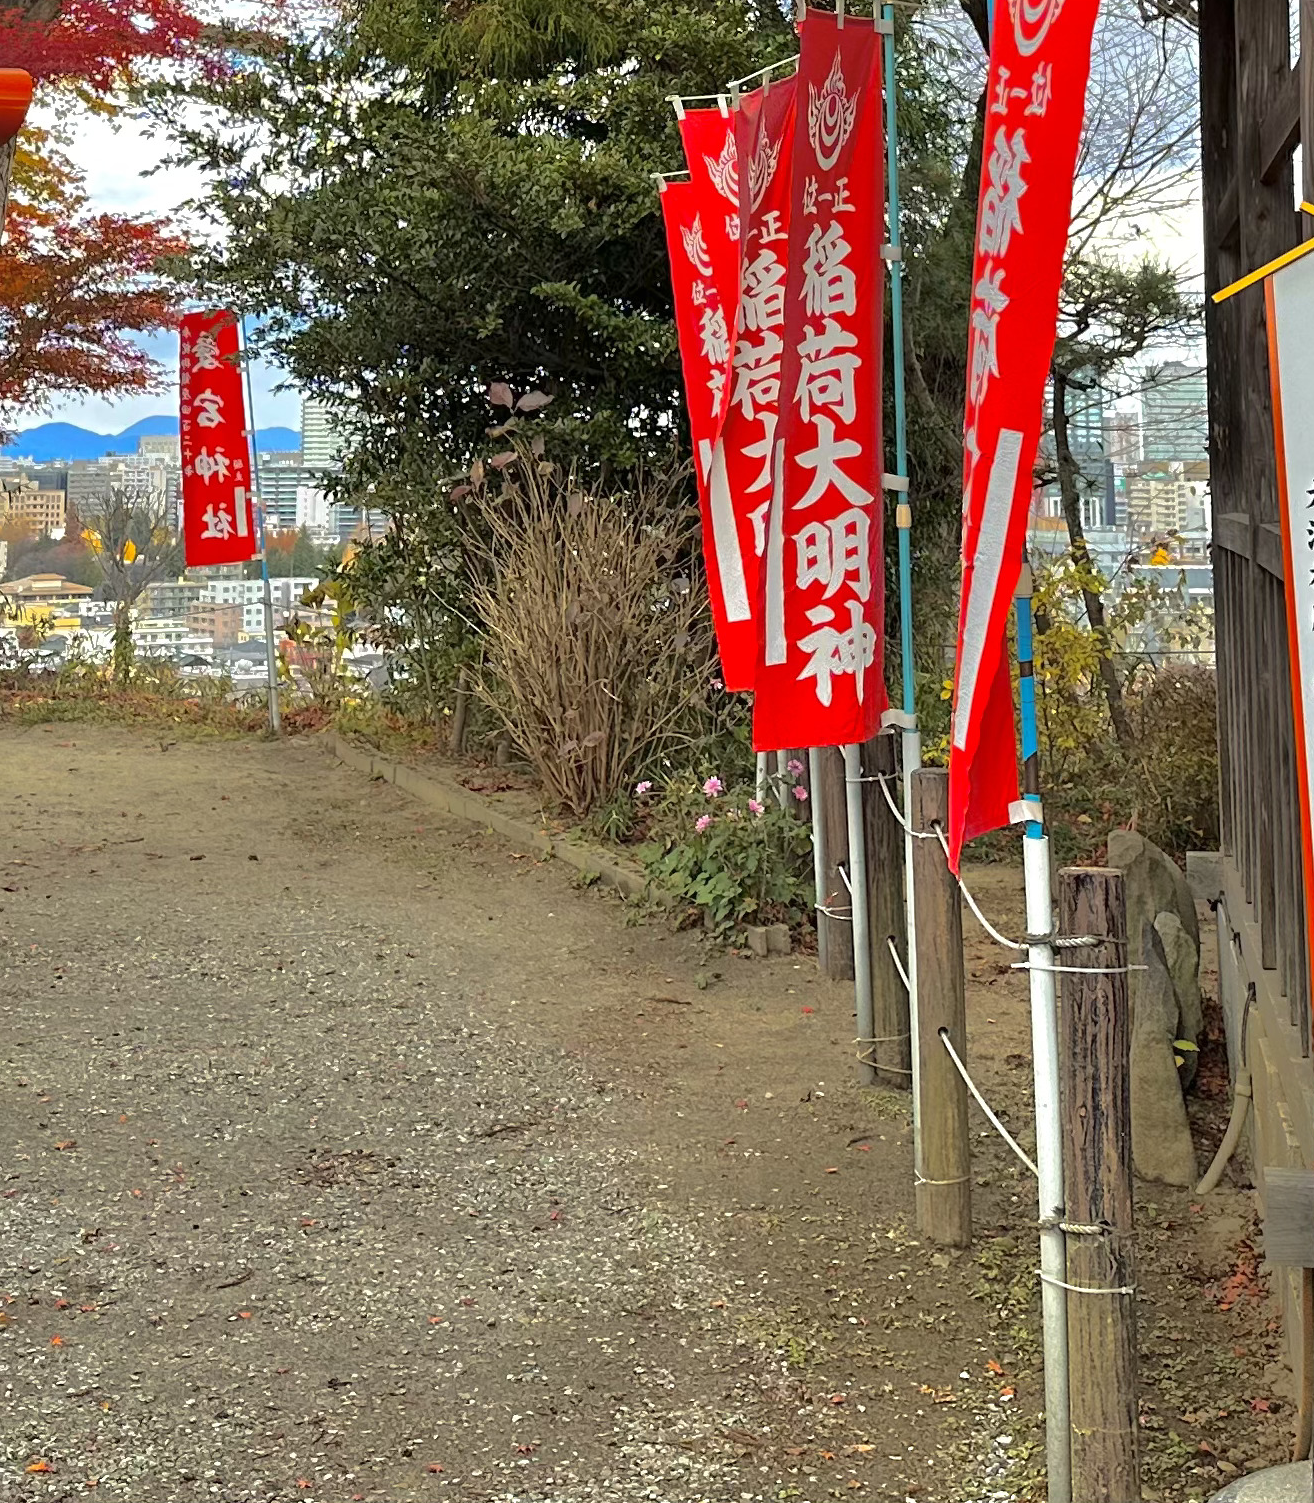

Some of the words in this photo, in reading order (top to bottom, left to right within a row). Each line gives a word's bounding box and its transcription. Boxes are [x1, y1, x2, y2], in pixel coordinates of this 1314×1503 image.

[790, 220, 876, 708] 稲荷大明神
